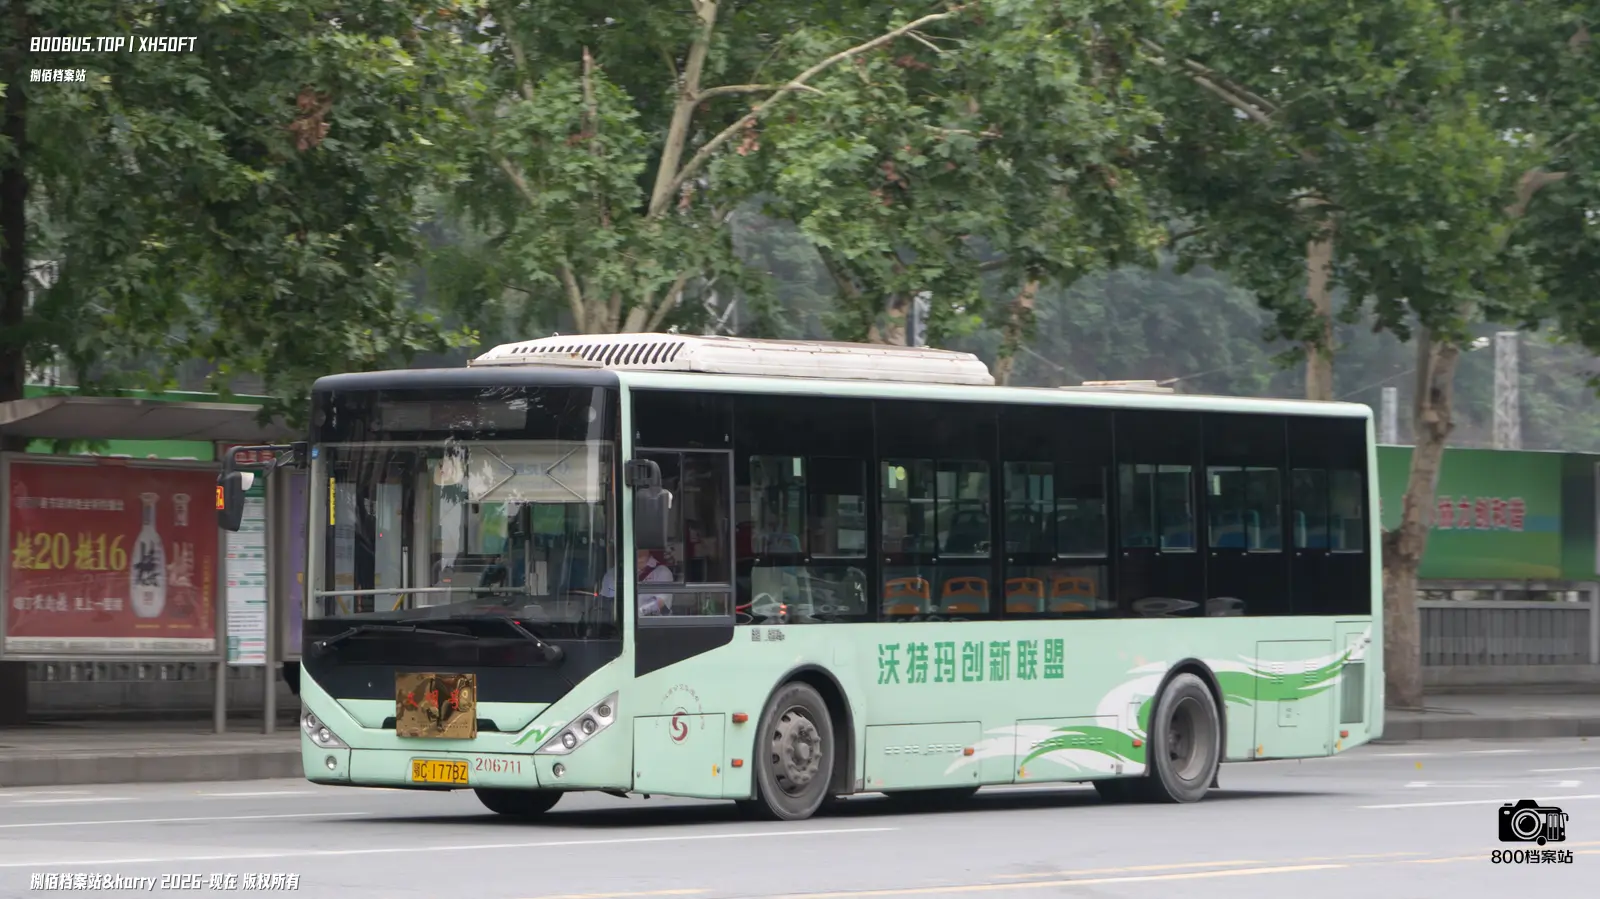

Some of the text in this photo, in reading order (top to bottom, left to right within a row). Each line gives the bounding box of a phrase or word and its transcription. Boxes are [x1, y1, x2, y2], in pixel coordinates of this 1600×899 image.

[877, 638, 1065, 685] 沃特玛创新联盟
[475, 757, 522, 774] 206711
